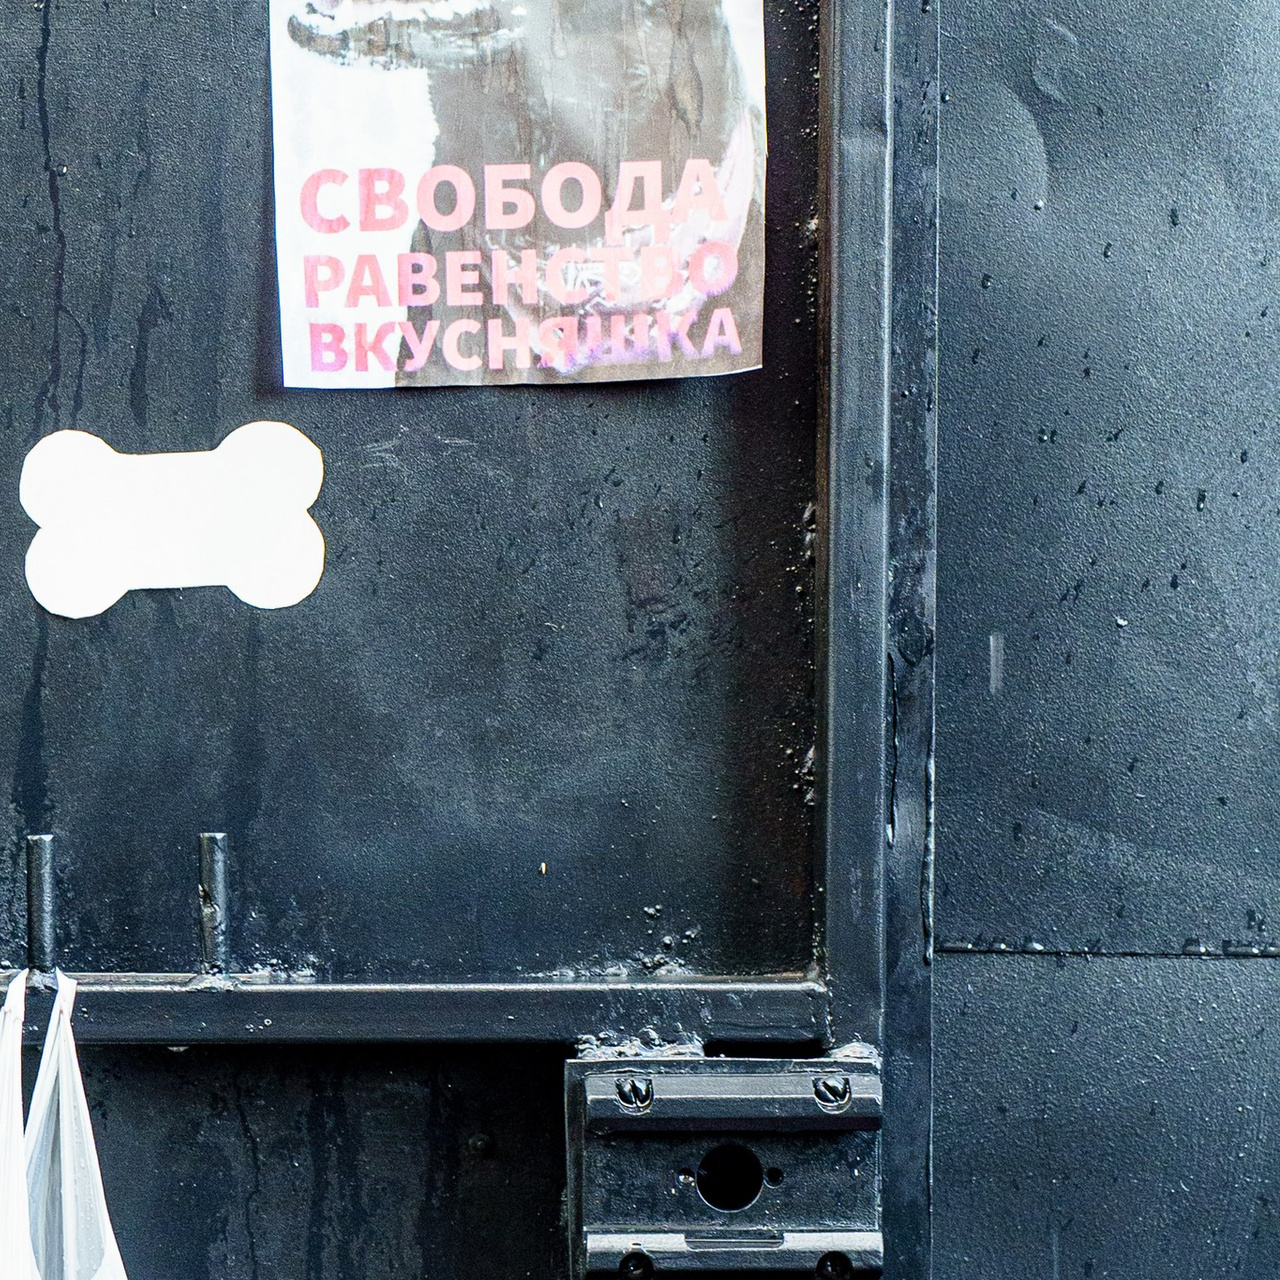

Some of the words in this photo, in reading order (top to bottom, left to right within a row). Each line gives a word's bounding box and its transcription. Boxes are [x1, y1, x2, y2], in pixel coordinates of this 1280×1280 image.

[299, 158, 729, 244] СВОБОДА
[303, 240, 739, 309] РАВЕНСТВО
[309, 308, 742, 373] ВКУСНЯШКА
